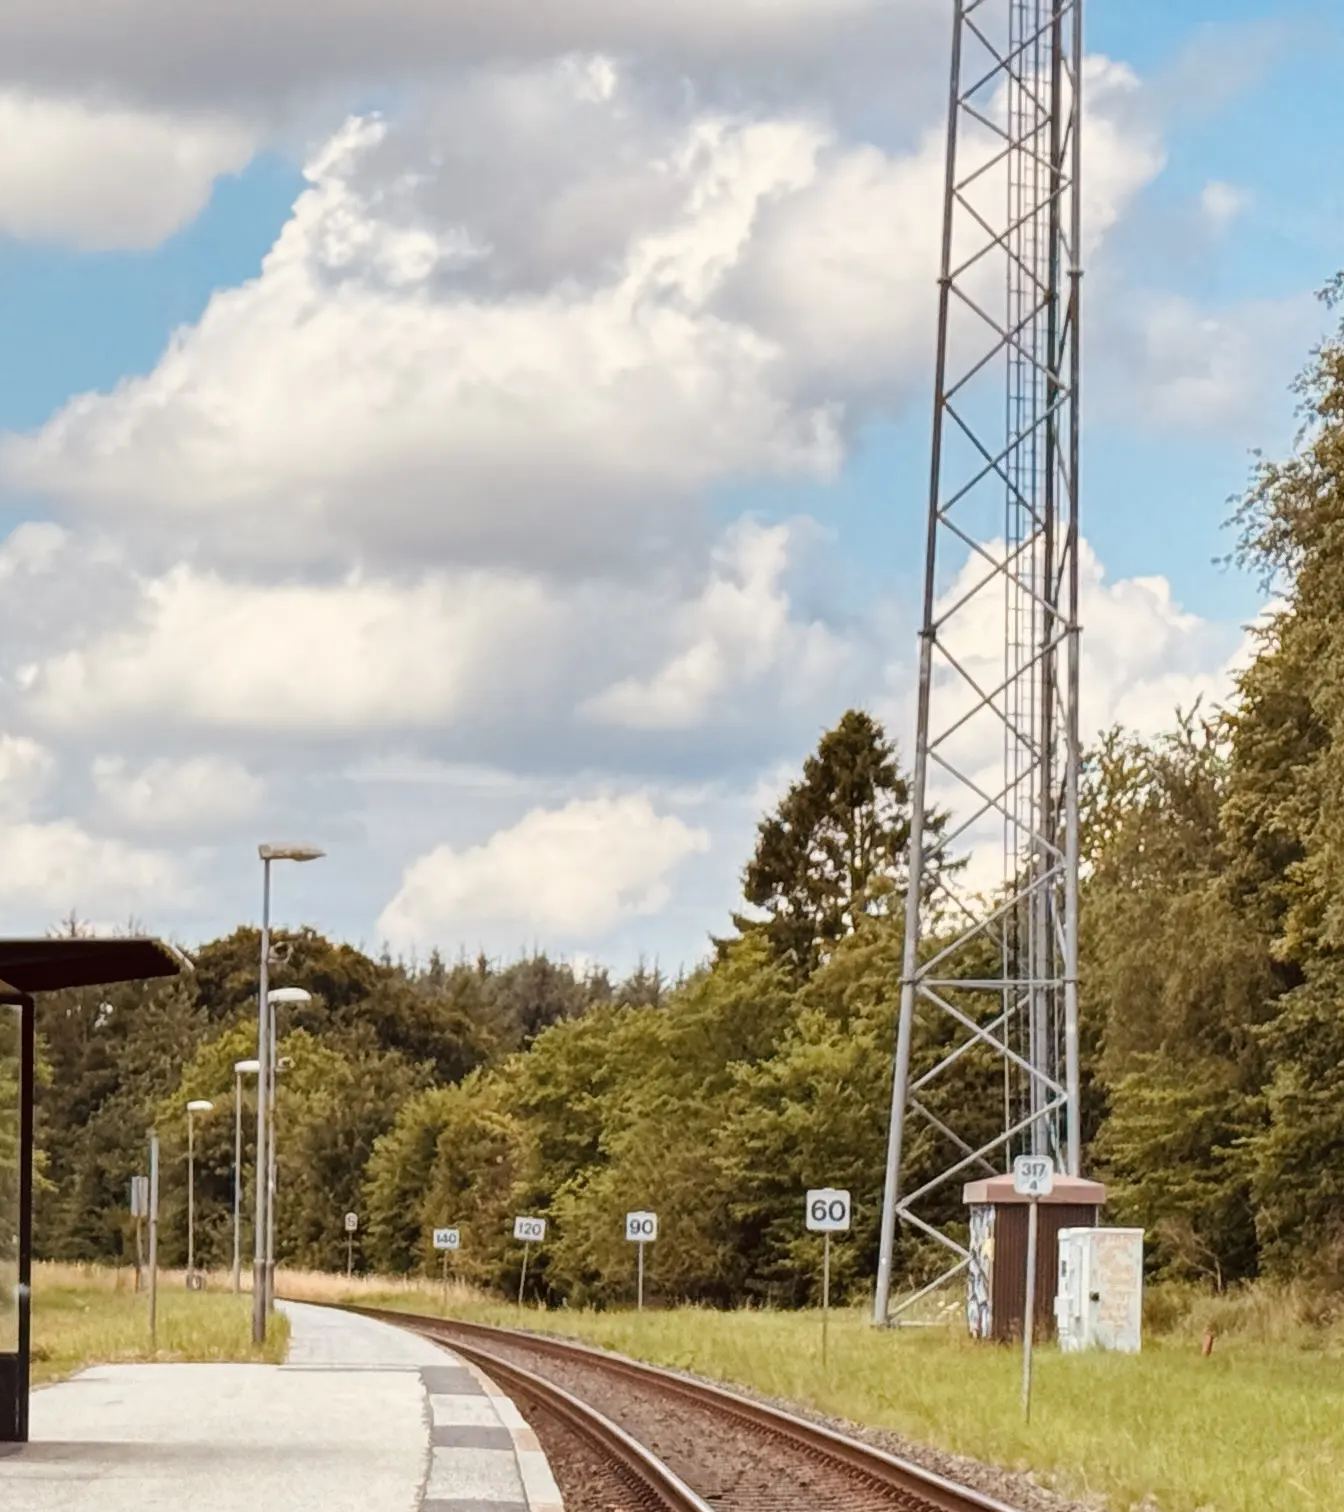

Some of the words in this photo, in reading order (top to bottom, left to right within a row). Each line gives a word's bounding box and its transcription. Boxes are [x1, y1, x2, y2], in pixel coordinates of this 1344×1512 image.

[1021, 1162, 1046, 1177] 317
[811, 1199, 846, 1222] 60
[518, 1222, 542, 1236] 120
[629, 1219, 654, 1235] 90
[436, 1233, 457, 1243] 140
